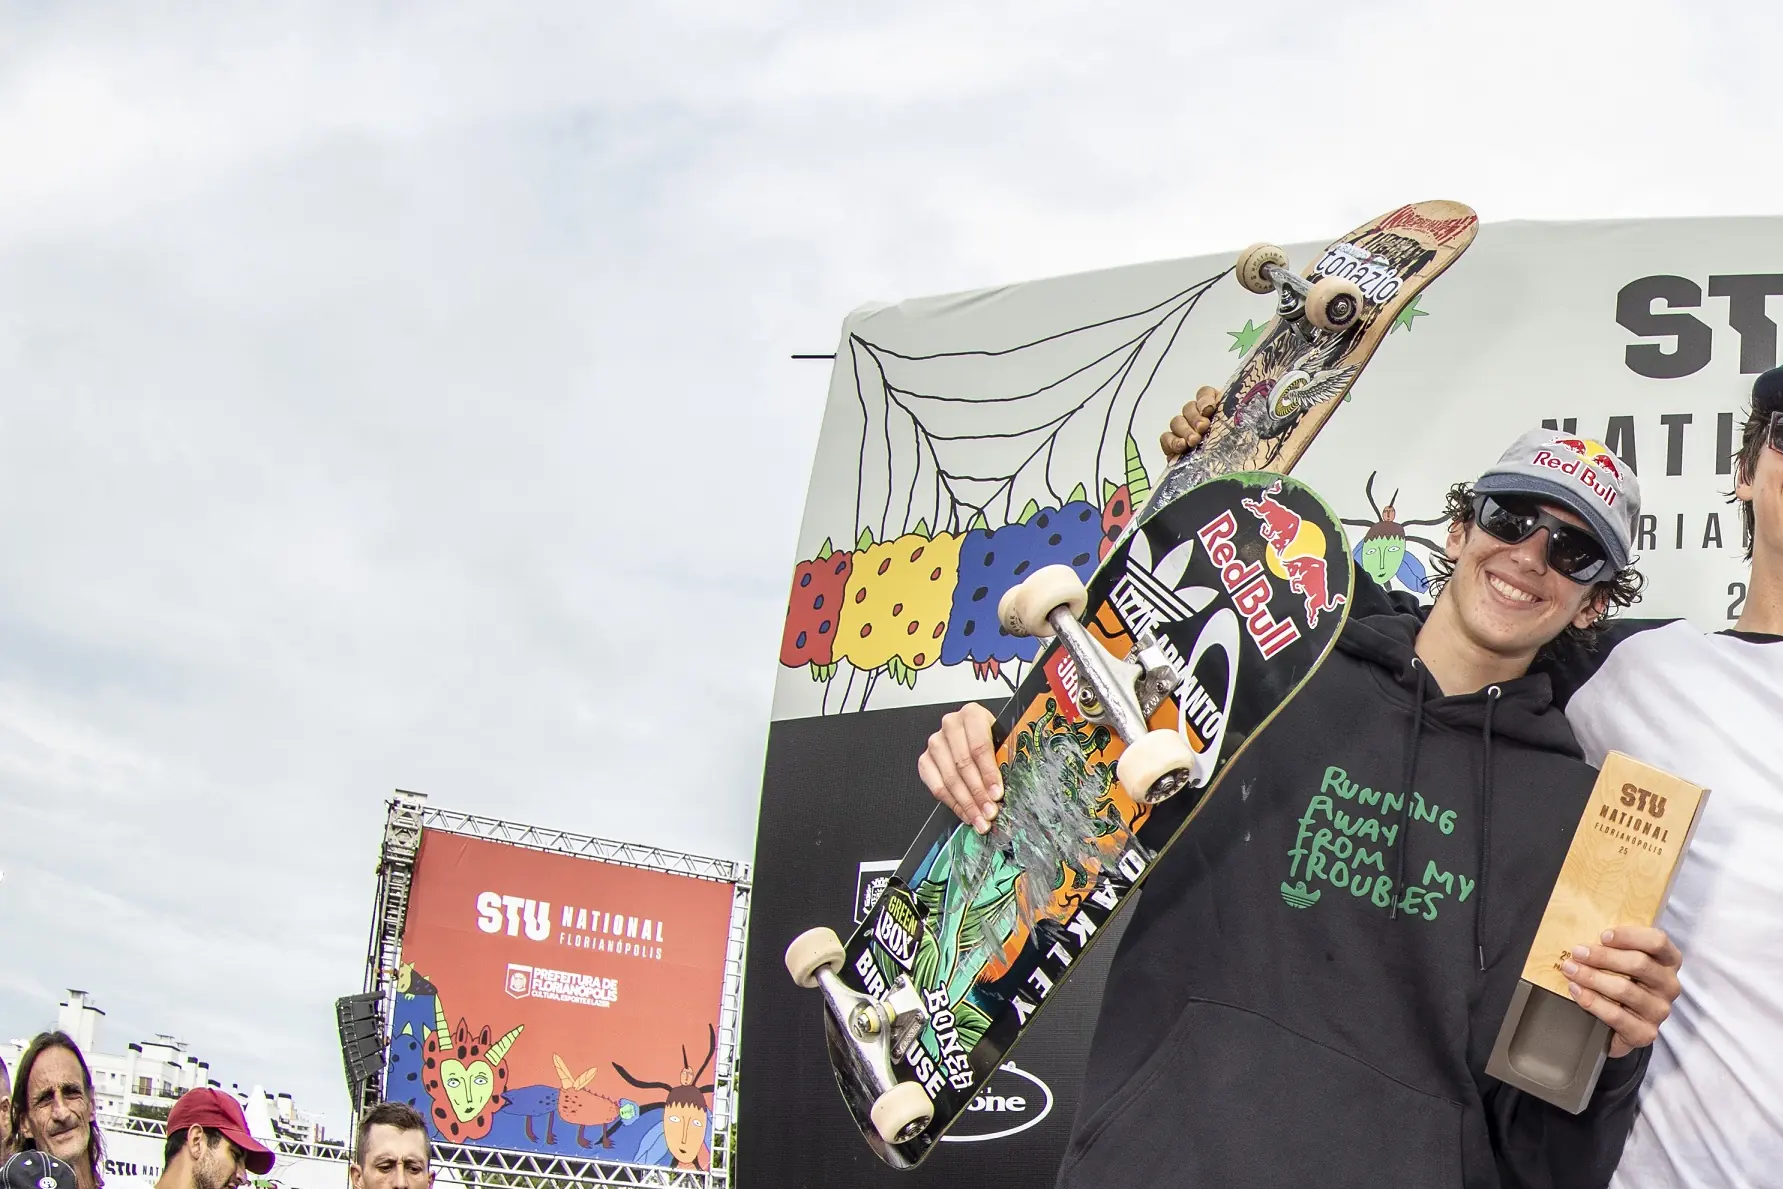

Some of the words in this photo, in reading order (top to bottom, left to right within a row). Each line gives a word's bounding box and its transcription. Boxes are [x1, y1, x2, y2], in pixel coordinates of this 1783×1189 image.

[1532, 450, 1580, 476] Red
[1579, 462, 1617, 506] Bull
[1198, 509, 1260, 593] Red
[1234, 571, 1302, 661] Bull
[1303, 795, 1399, 847] AWAY
[1599, 804, 1669, 843] NATIONAL
[1620, 783, 1667, 818] STU
[1298, 818, 1385, 871] FROM
[1422, 860, 1476, 902] MY
[1618, 846, 1629, 855] 25
[1287, 848, 1444, 921] TROUBES
[476, 891, 550, 942] STU
[561, 905, 664, 943] NATIONAL
[881, 914, 913, 960] BOX
[887, 895, 918, 937] GREEN
[1011, 849, 1147, 1025] OAKLEY
[559, 932, 663, 960] FLORIANÓPOLIS
[533, 967, 600, 987] PREFEITURA
[600, 977, 618, 990] DE
[923, 981, 974, 1089] BONES
